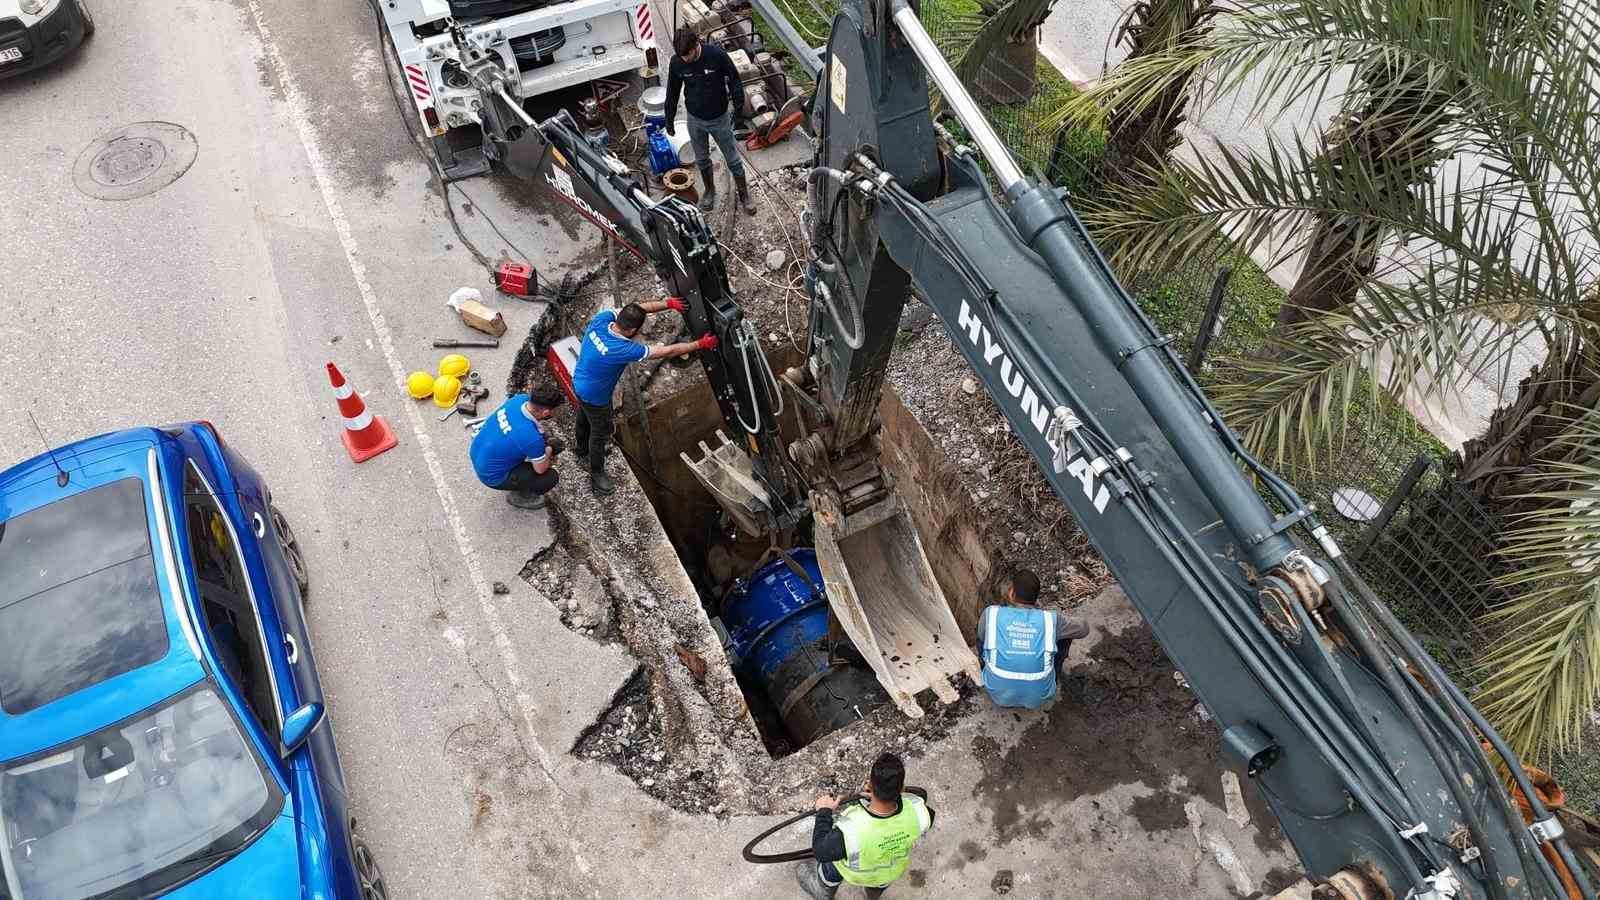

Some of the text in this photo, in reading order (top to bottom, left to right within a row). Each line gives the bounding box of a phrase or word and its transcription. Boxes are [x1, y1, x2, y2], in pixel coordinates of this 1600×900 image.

[1, 48, 20, 60] 316
[588, 331, 609, 356] asat
[957, 299, 1112, 515] HYUNAI
[496, 408, 513, 435] asat
